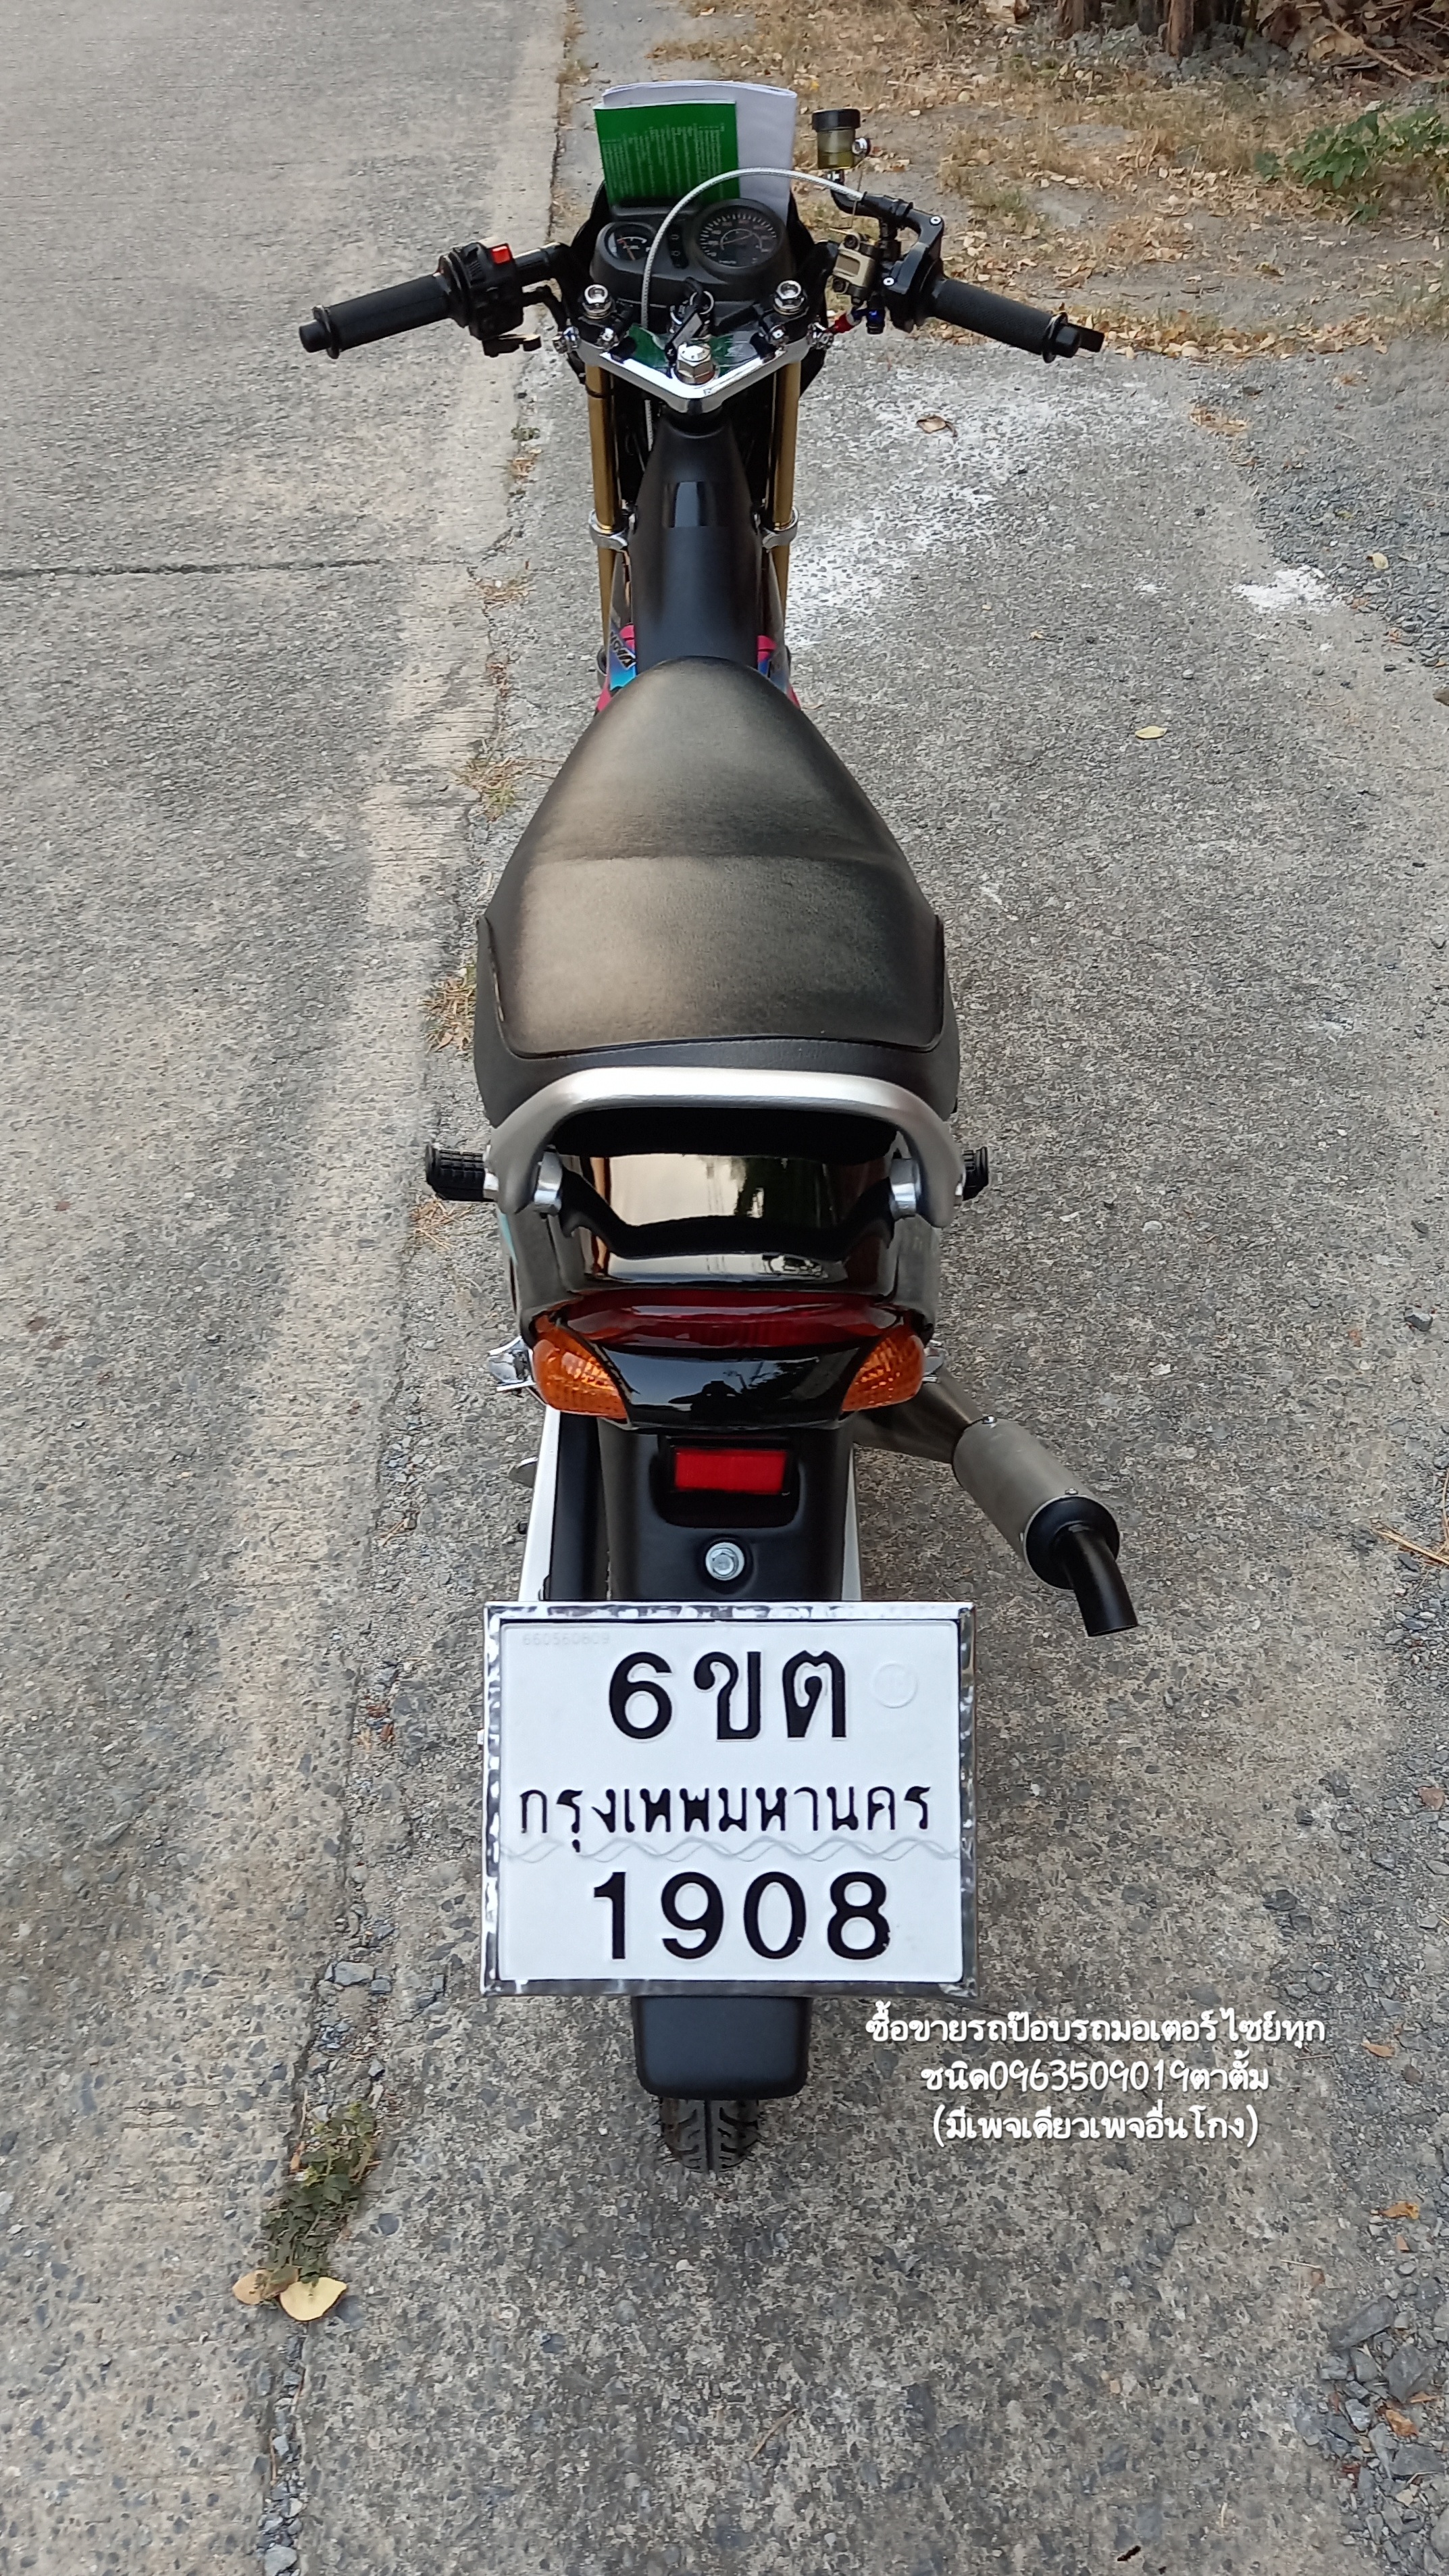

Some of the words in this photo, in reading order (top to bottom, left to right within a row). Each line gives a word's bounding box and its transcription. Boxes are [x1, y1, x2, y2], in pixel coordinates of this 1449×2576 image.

[609, 1650, 846, 1740] 6ขต
[519, 1786, 931, 1852] กรุงเทพมหานคร
[593, 1871, 890, 1960] 1908
